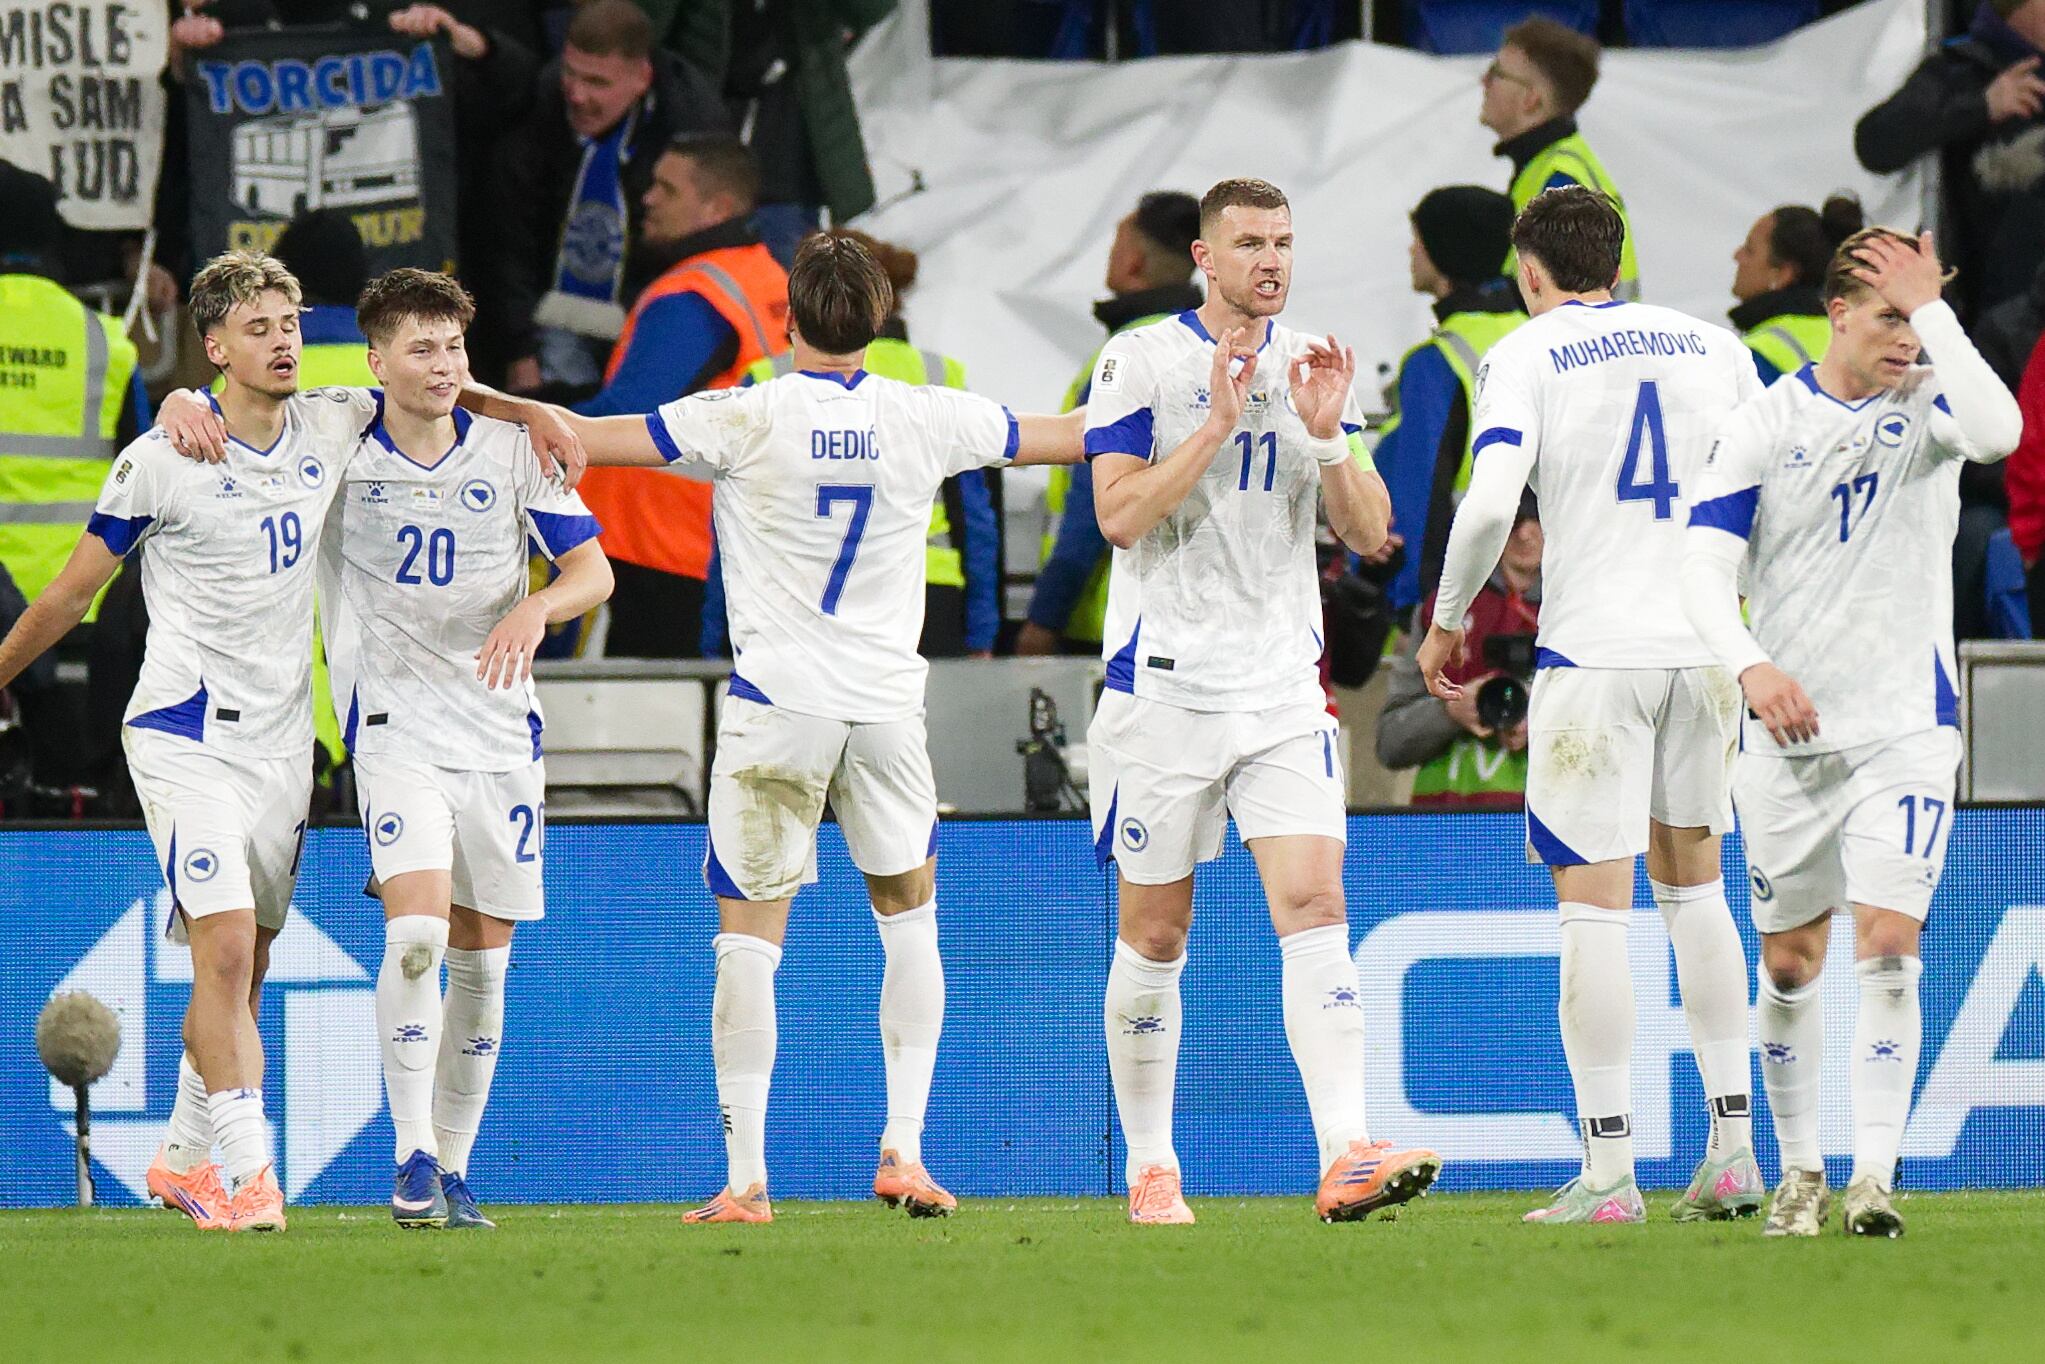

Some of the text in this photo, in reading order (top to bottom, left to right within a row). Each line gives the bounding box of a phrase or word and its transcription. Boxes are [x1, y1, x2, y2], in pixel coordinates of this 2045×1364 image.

[49, 73, 141, 130] SAM
[198, 42, 442, 115] TORCIDA
[1549, 330, 1706, 374] MUHAREMOVIĆ
[811, 424, 879, 460] DEDIĆ
[1234, 430, 1276, 491] 11
[1615, 379, 1682, 522] 4
[1831, 472, 1878, 543] 17
[260, 511, 302, 574] 19
[396, 525, 455, 587] 20
[814, 482, 875, 617] 7
[1898, 794, 1945, 859] 17
